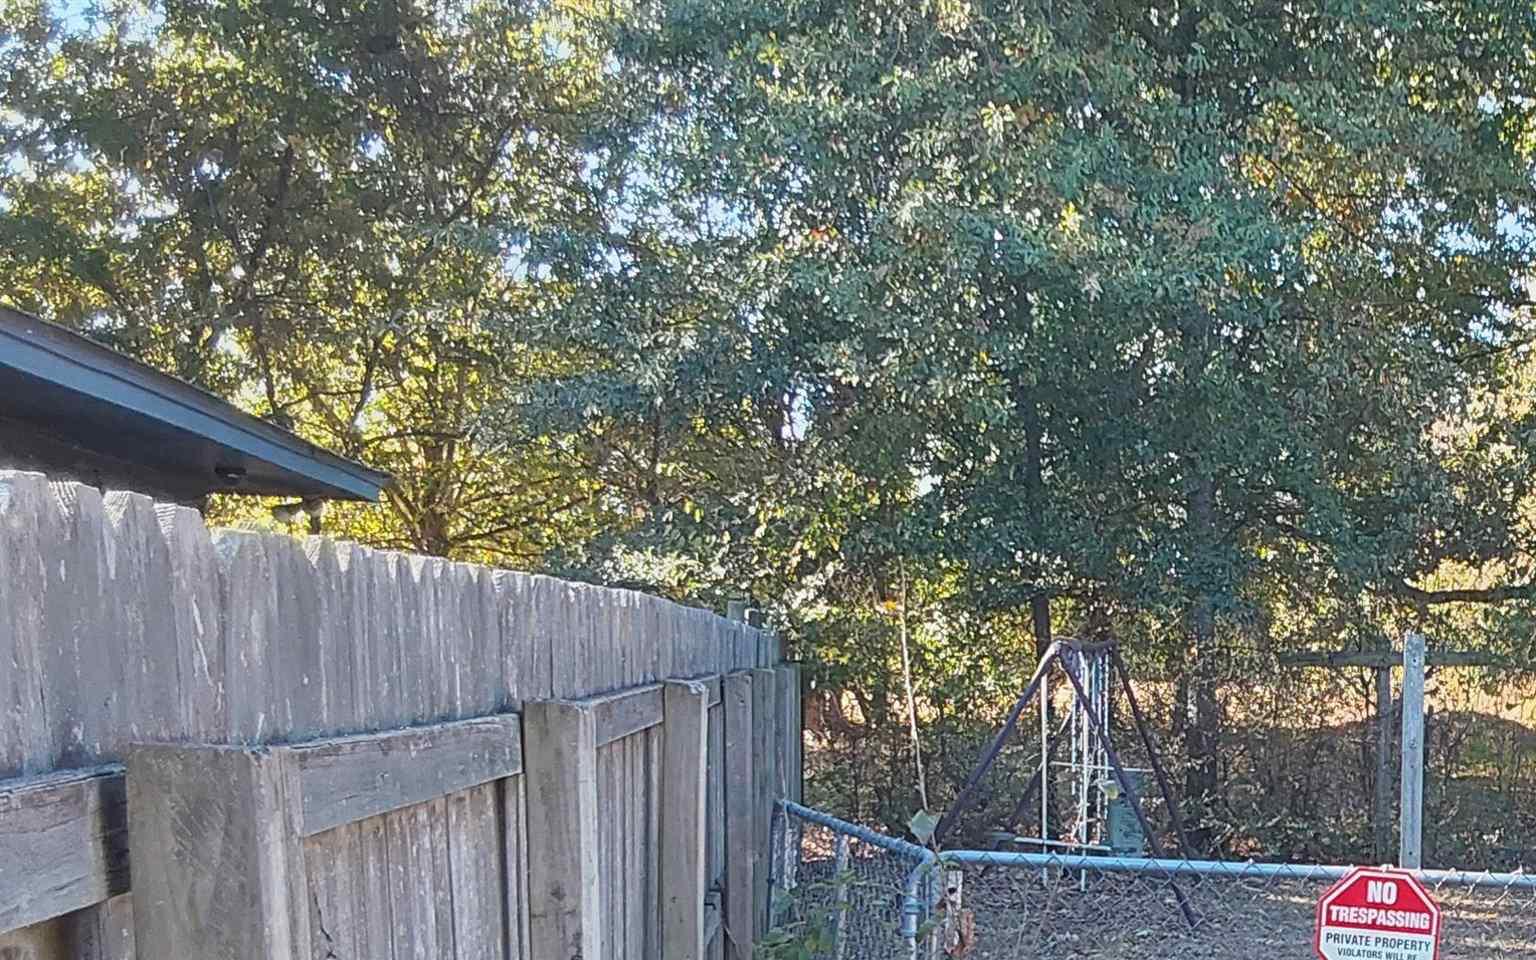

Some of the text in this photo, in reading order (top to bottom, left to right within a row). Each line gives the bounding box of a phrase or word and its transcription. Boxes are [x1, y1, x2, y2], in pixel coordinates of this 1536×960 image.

[1366, 880, 1398, 905] NO
[1329, 905, 1431, 930] TRESPASSING
[1326, 932, 1432, 952] PRIVATE PROPERTY
[1337, 947, 1383, 960] VIOLATORS
